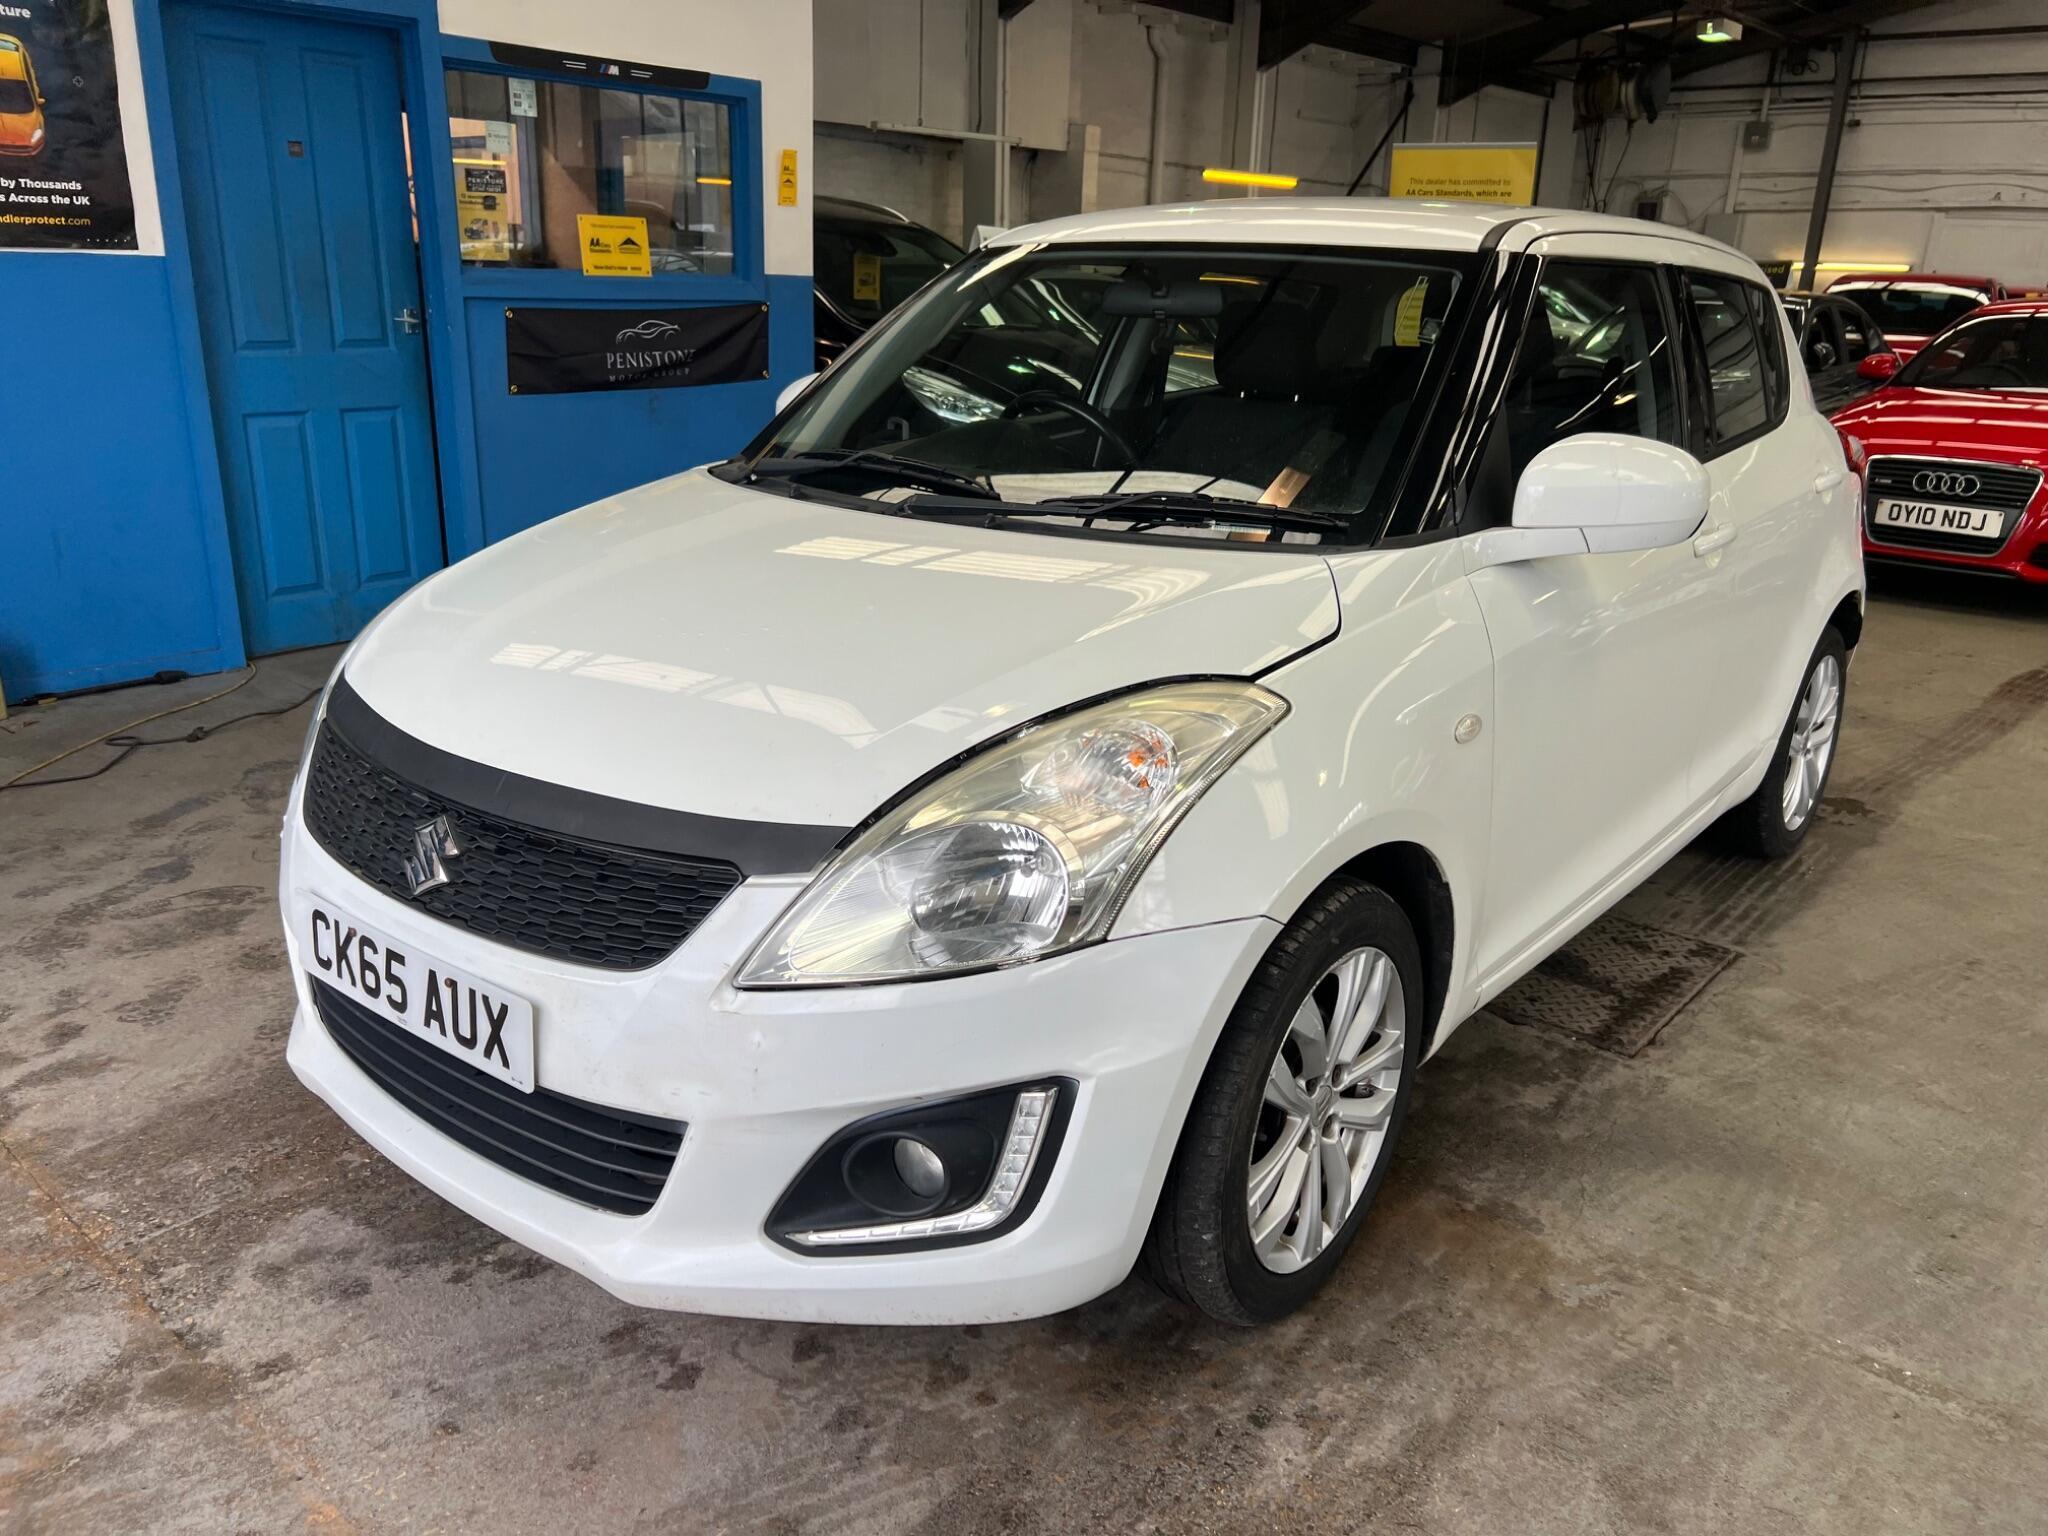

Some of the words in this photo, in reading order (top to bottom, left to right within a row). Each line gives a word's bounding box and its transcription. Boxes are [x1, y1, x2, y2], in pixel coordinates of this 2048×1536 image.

[0, 178, 15, 189] by
[18, 178, 82, 190] Thousands
[1410, 177, 1424, 185] This
[1425, 178, 1447, 186] dealer
[1449, 178, 1461, 186] has
[1462, 178, 1501, 186] committed
[9, 193, 49, 204] Across
[51, 195, 70, 205] the
[73, 196, 91, 206] UK
[1435, 189, 1474, 198] Standards,
[1476, 190, 1498, 198] which
[1888, 503, 1936, 525] OY10
[1940, 509, 1988, 531] NDJ
[311, 908, 408, 1014] CK65
[423, 968, 511, 1071] AUX
